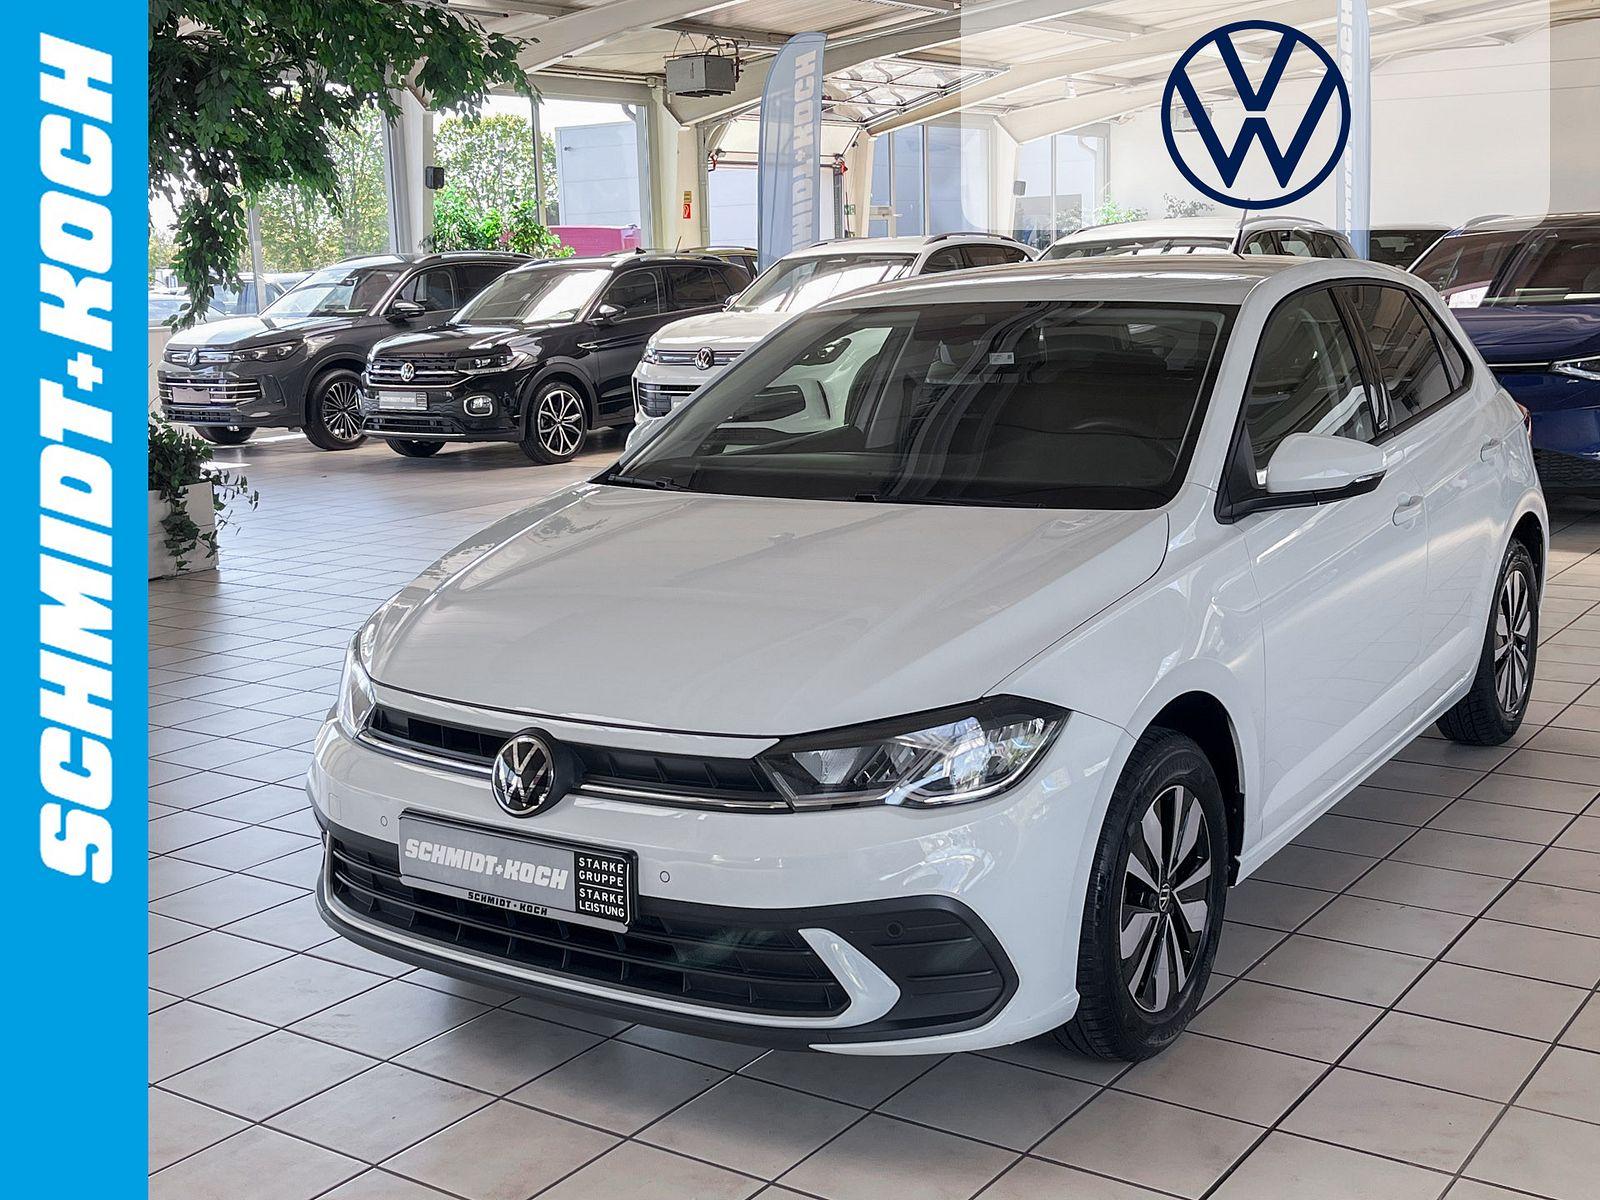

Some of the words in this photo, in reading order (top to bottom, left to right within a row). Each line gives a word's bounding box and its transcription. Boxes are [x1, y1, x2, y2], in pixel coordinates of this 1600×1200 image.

[493, 735, 555, 814] VW
[405, 838, 569, 890] SCHMIDT+KOCH
[579, 857, 624, 874] STARKE
[579, 870, 624, 887] GRUPPE
[468, 891, 511, 908] SCHMIDT
[520, 902, 547, 916] KOCH
[579, 888, 624, 905] STARKE
[579, 900, 625, 918] LEISTUNG
